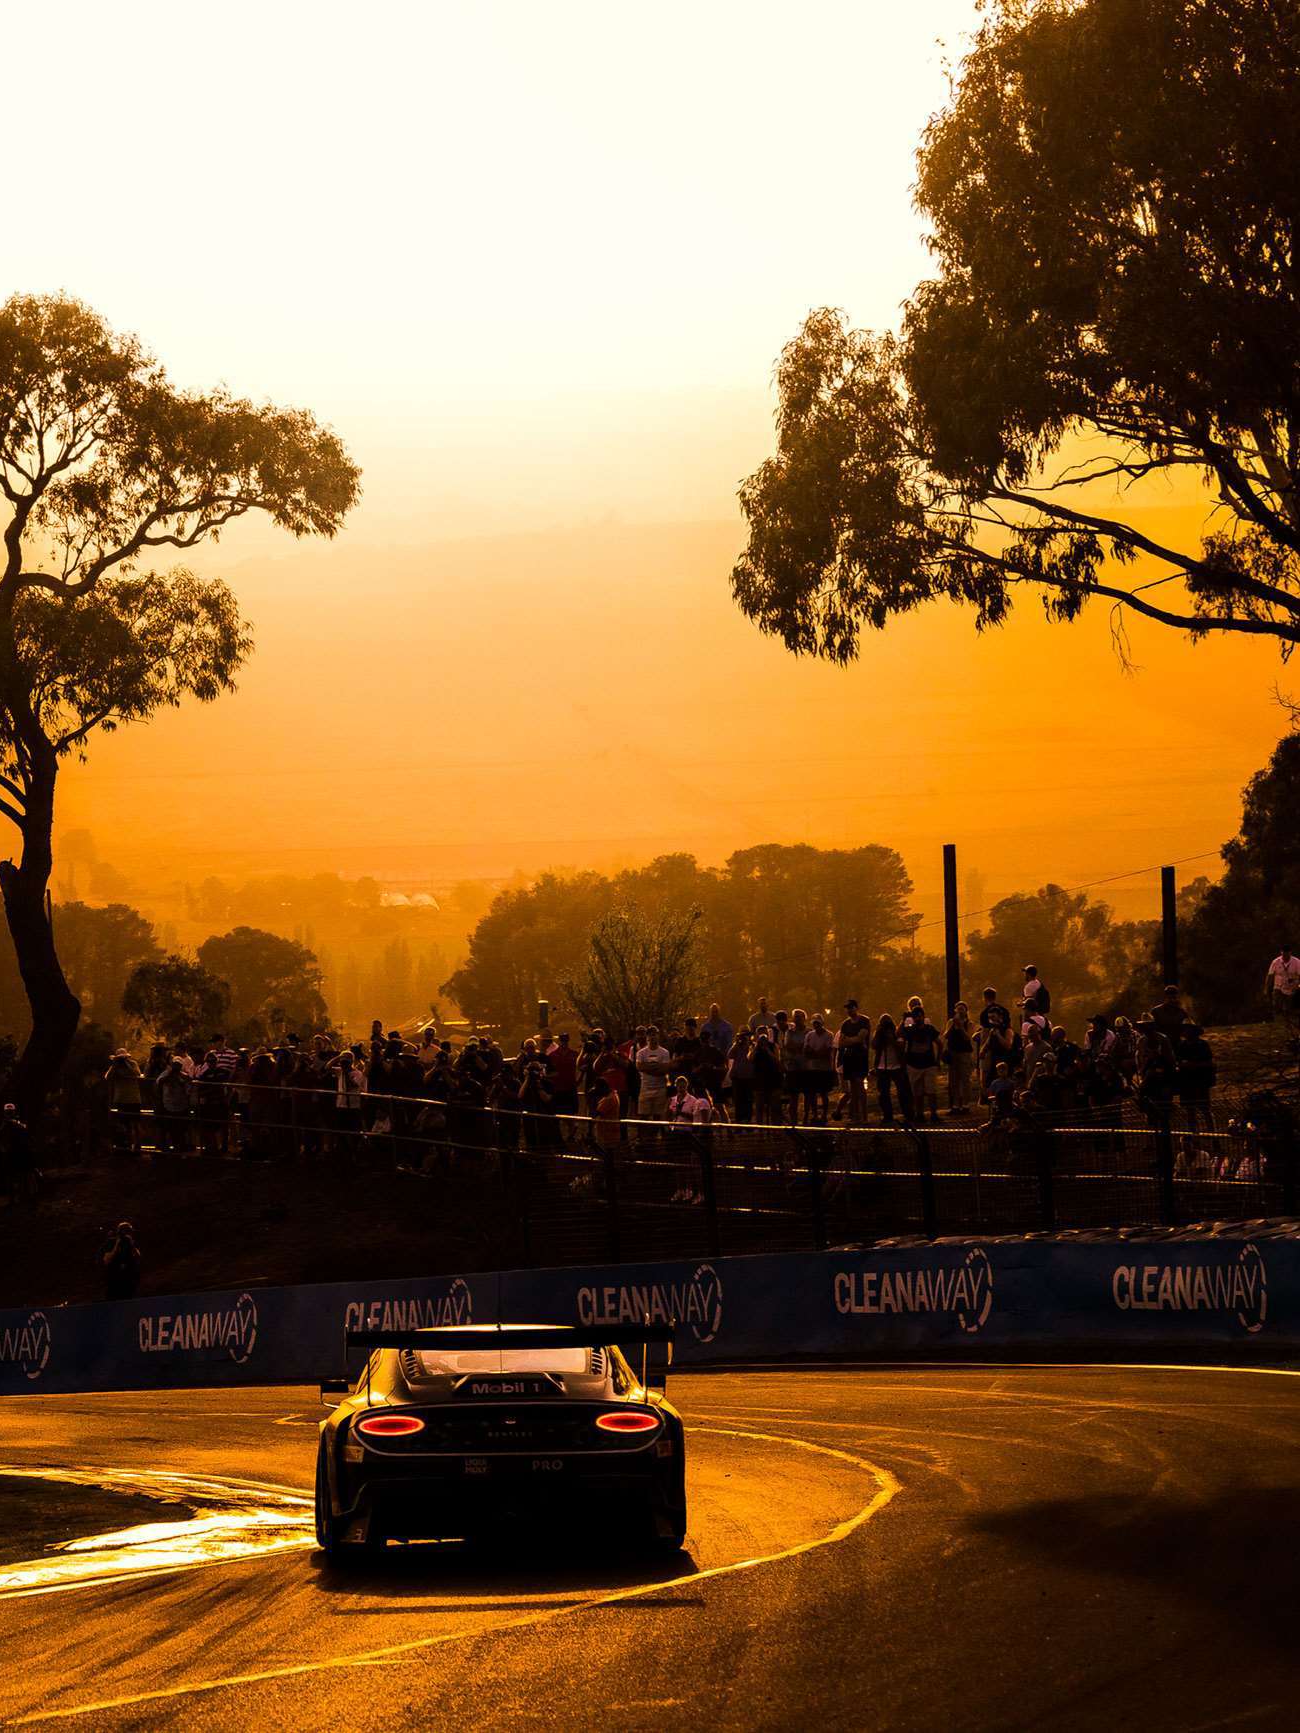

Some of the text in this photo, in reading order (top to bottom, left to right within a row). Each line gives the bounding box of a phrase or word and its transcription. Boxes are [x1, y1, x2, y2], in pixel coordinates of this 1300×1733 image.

[577, 1282, 714, 1328] CLEANAWAY
[834, 1267, 984, 1314] CLEANAWAY
[1113, 1264, 1258, 1311] CLEANAWAY
[139, 1310, 252, 1352] CLEANAWAY
[345, 1296, 466, 1333] CLEANAWAY
[471, 1382, 541, 1395] Mobil 1
[531, 1459, 564, 1471] PRO
